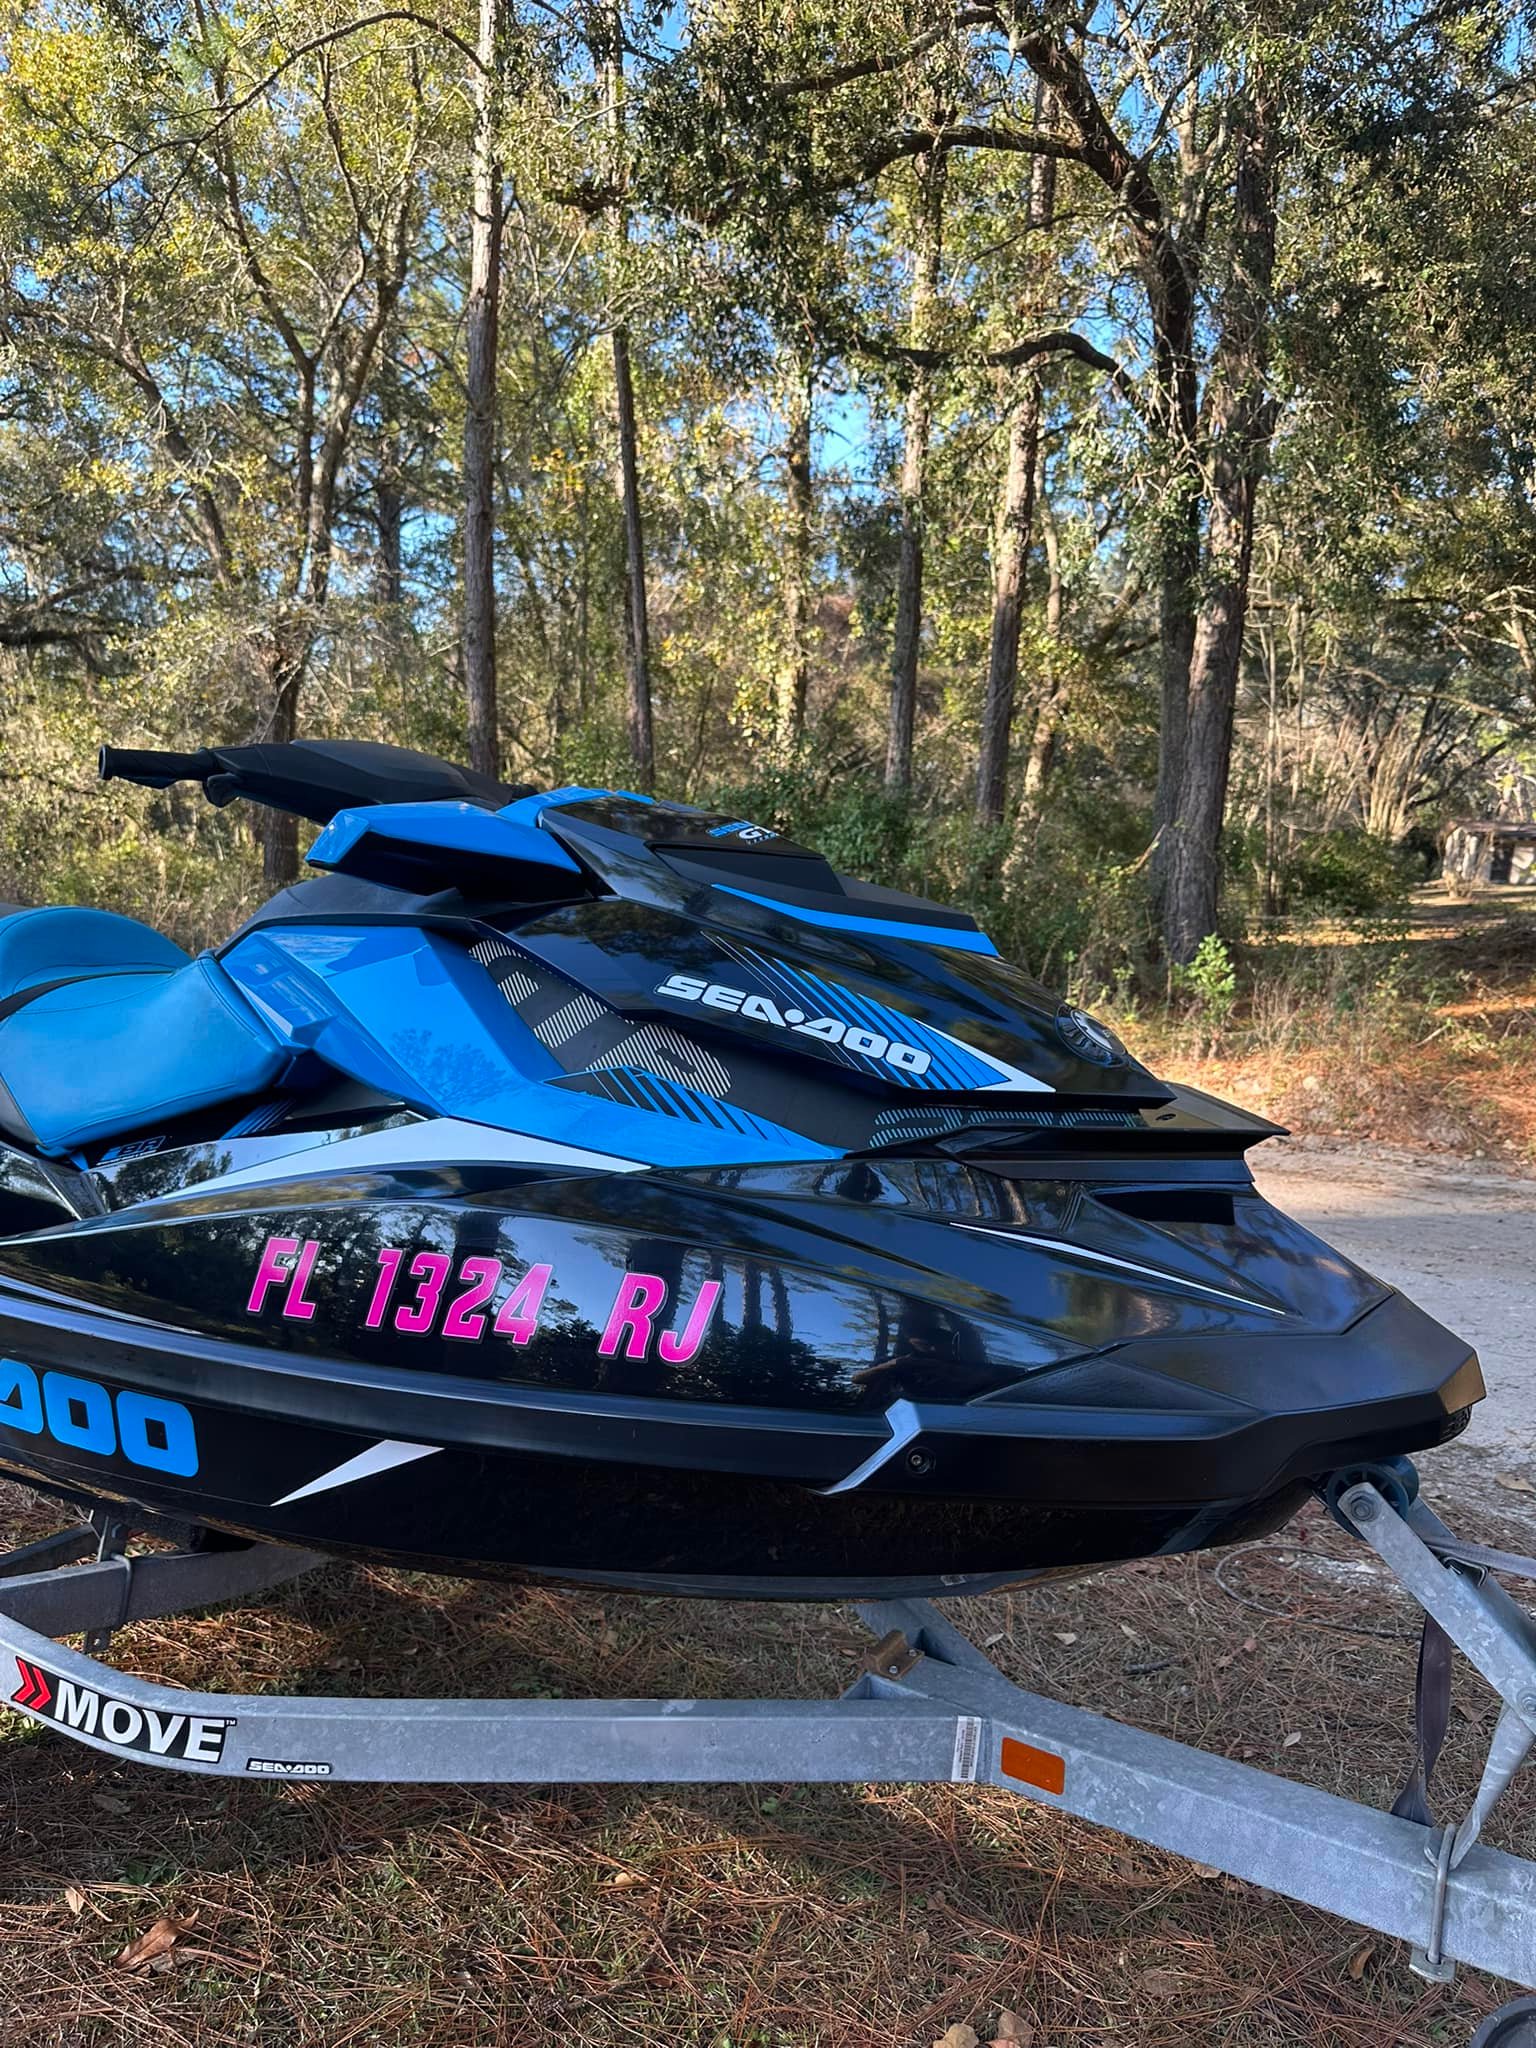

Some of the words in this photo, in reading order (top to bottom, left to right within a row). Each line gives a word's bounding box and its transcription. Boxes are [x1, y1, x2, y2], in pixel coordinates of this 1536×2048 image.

[247, 1237, 320, 1320] FL
[364, 1248, 553, 1346] 1324
[598, 1273, 721, 1364] RJ
